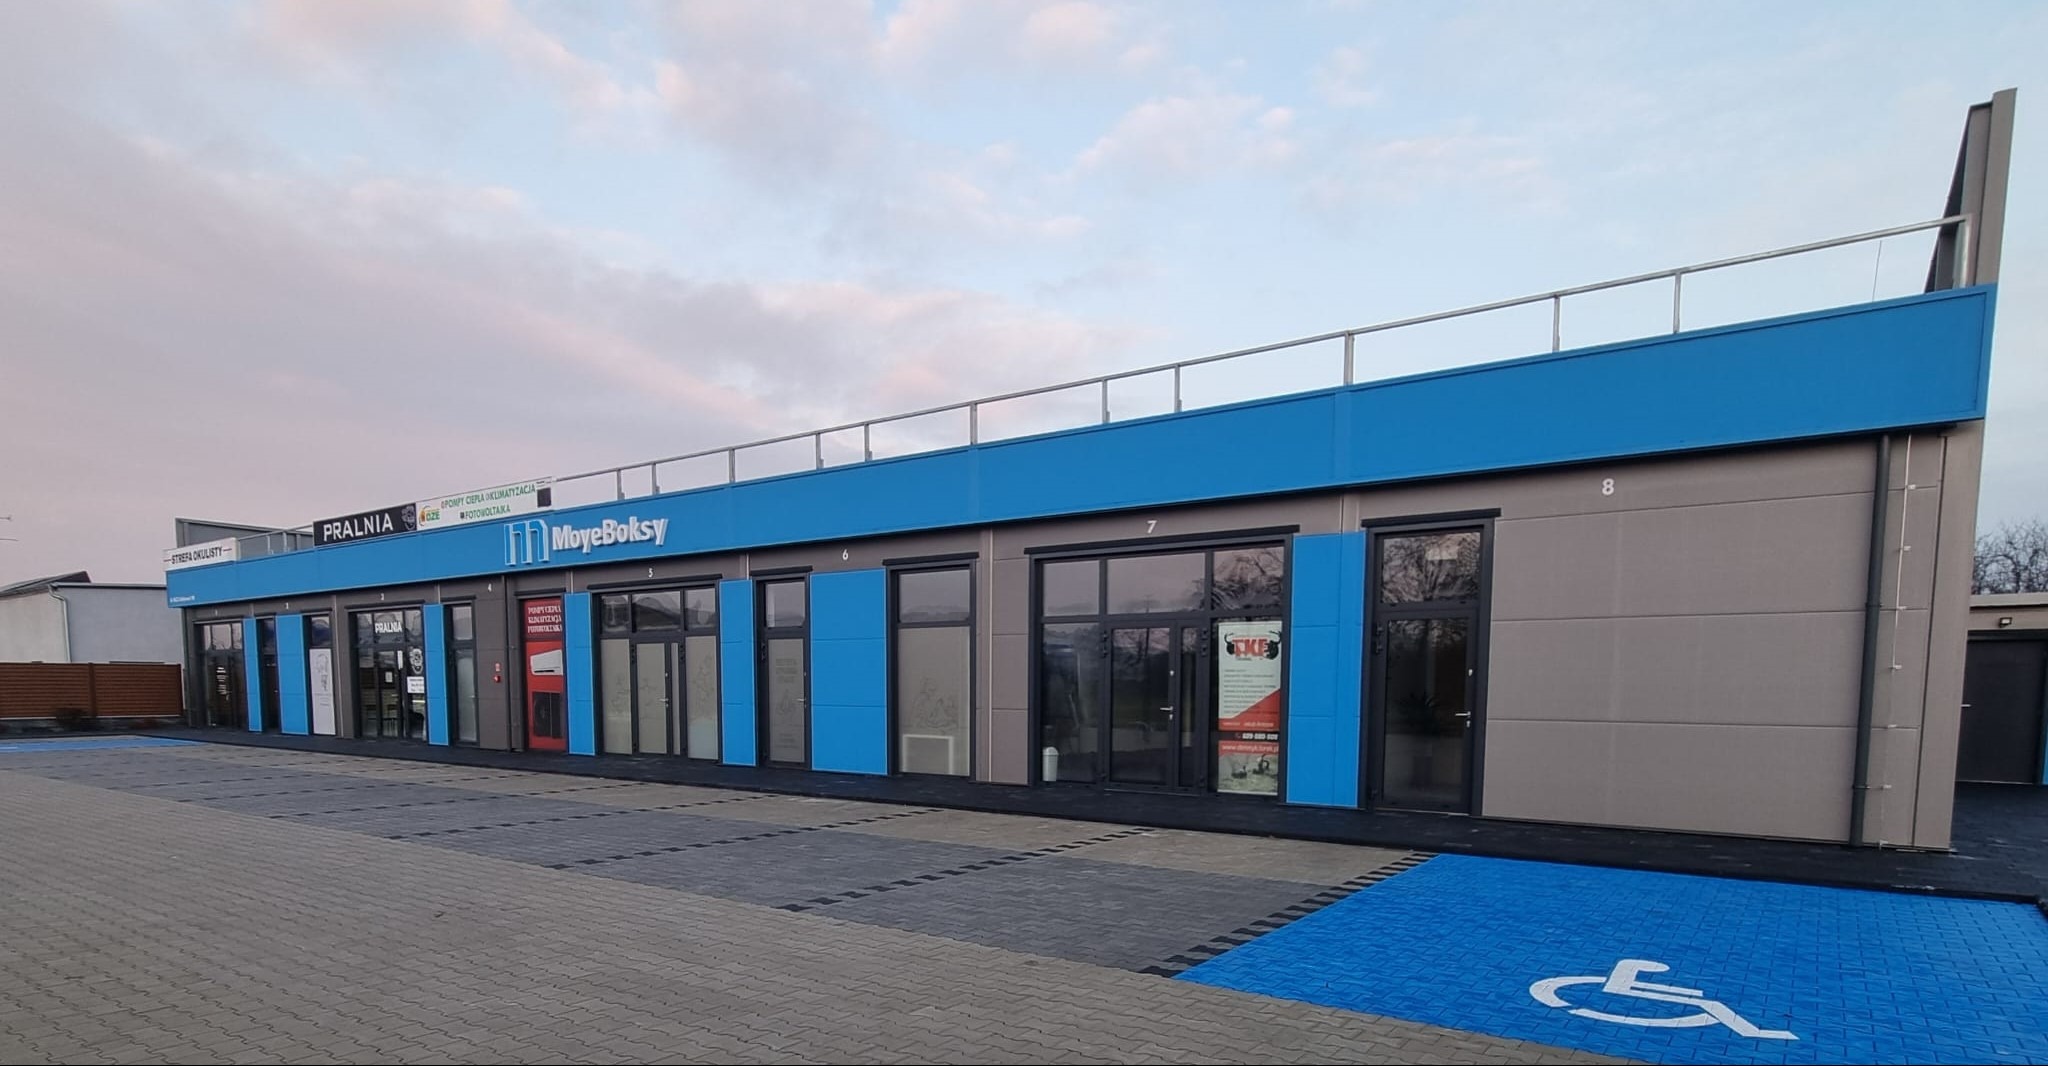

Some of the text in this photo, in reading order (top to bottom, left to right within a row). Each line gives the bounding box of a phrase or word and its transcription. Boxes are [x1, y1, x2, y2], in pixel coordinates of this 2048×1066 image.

[1602, 478, 1614, 495] 8
[323, 512, 394, 542] PRALNIA
[1146, 520, 1157, 533] 7
[552, 516, 669, 554] MoyeBoksy
[842, 550, 849, 560] 6
[375, 621, 403, 634] PRALNIA
